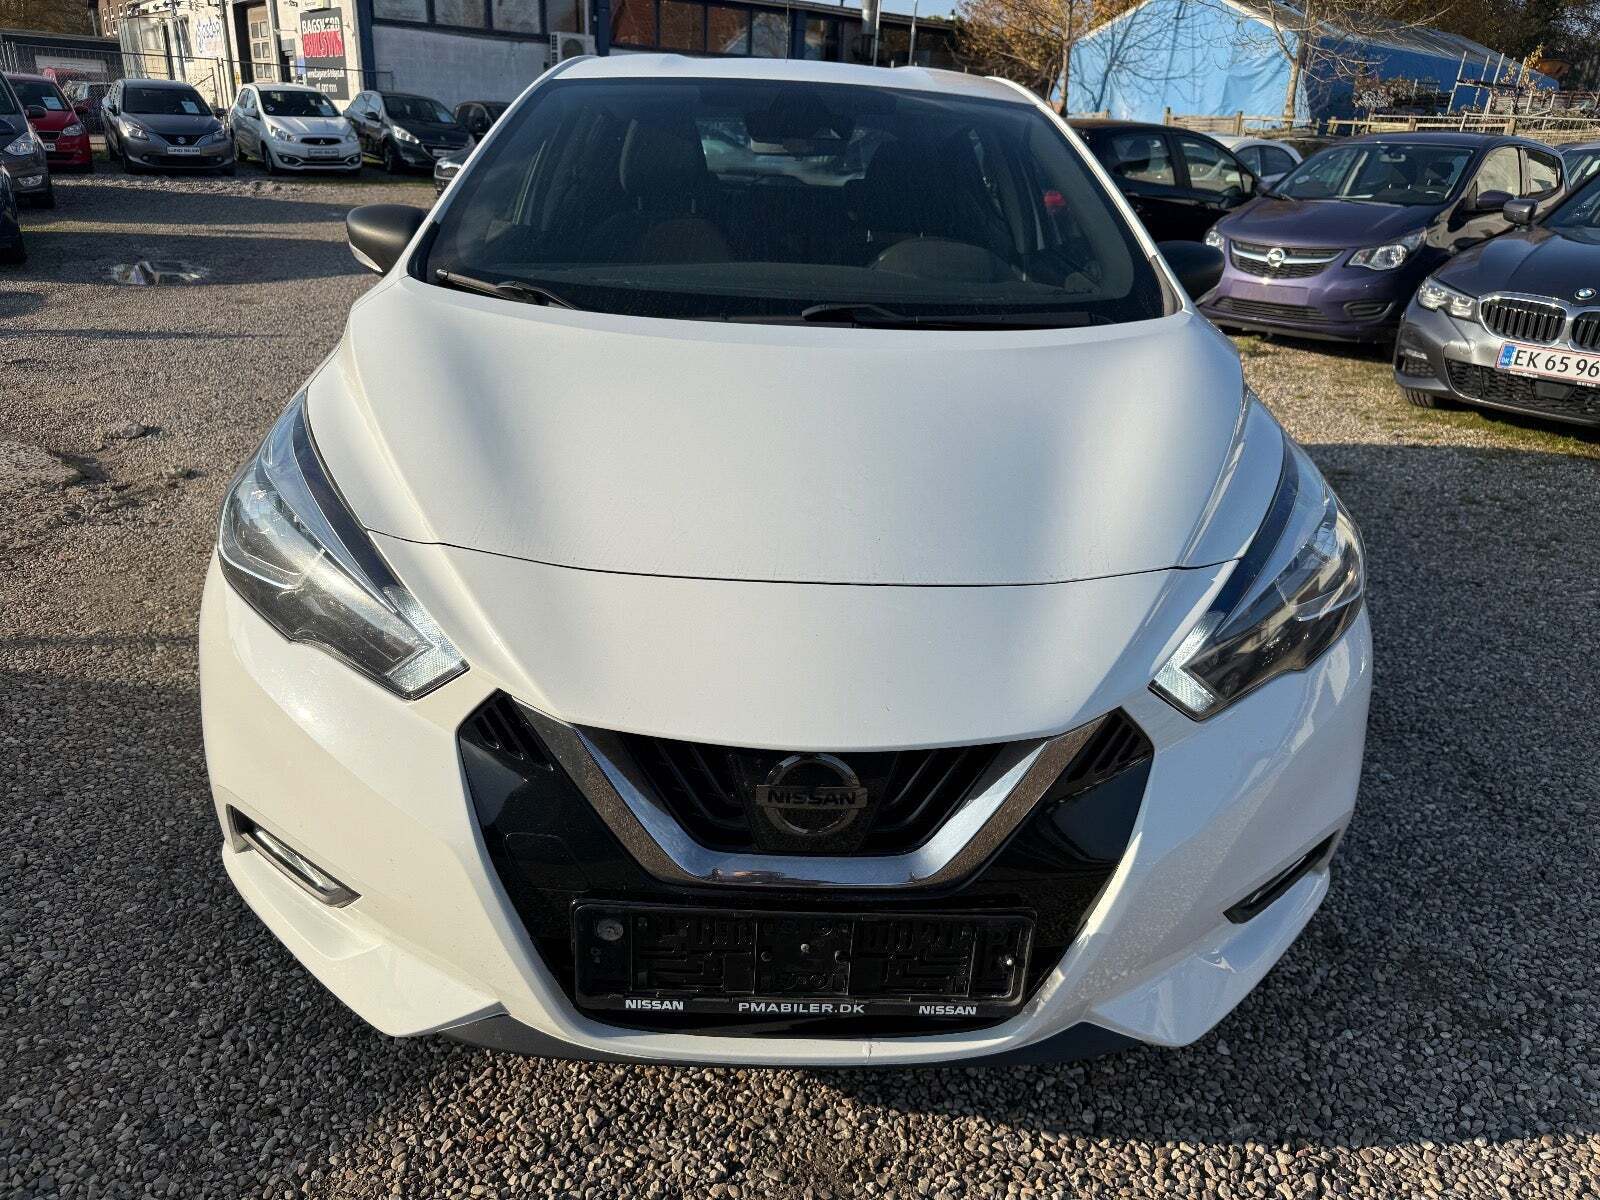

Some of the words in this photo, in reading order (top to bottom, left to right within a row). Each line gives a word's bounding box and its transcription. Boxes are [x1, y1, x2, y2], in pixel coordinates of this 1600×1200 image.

[1513, 350, 1541, 368] EK
[1545, 354, 1571, 372] 65
[1575, 359, 1600, 377] 96
[767, 791, 856, 805] NISSAN
[625, 999, 684, 1010] NISSAN
[738, 1001, 865, 1014] PMABILER.DK
[918, 1004, 977, 1016] NISSAN
